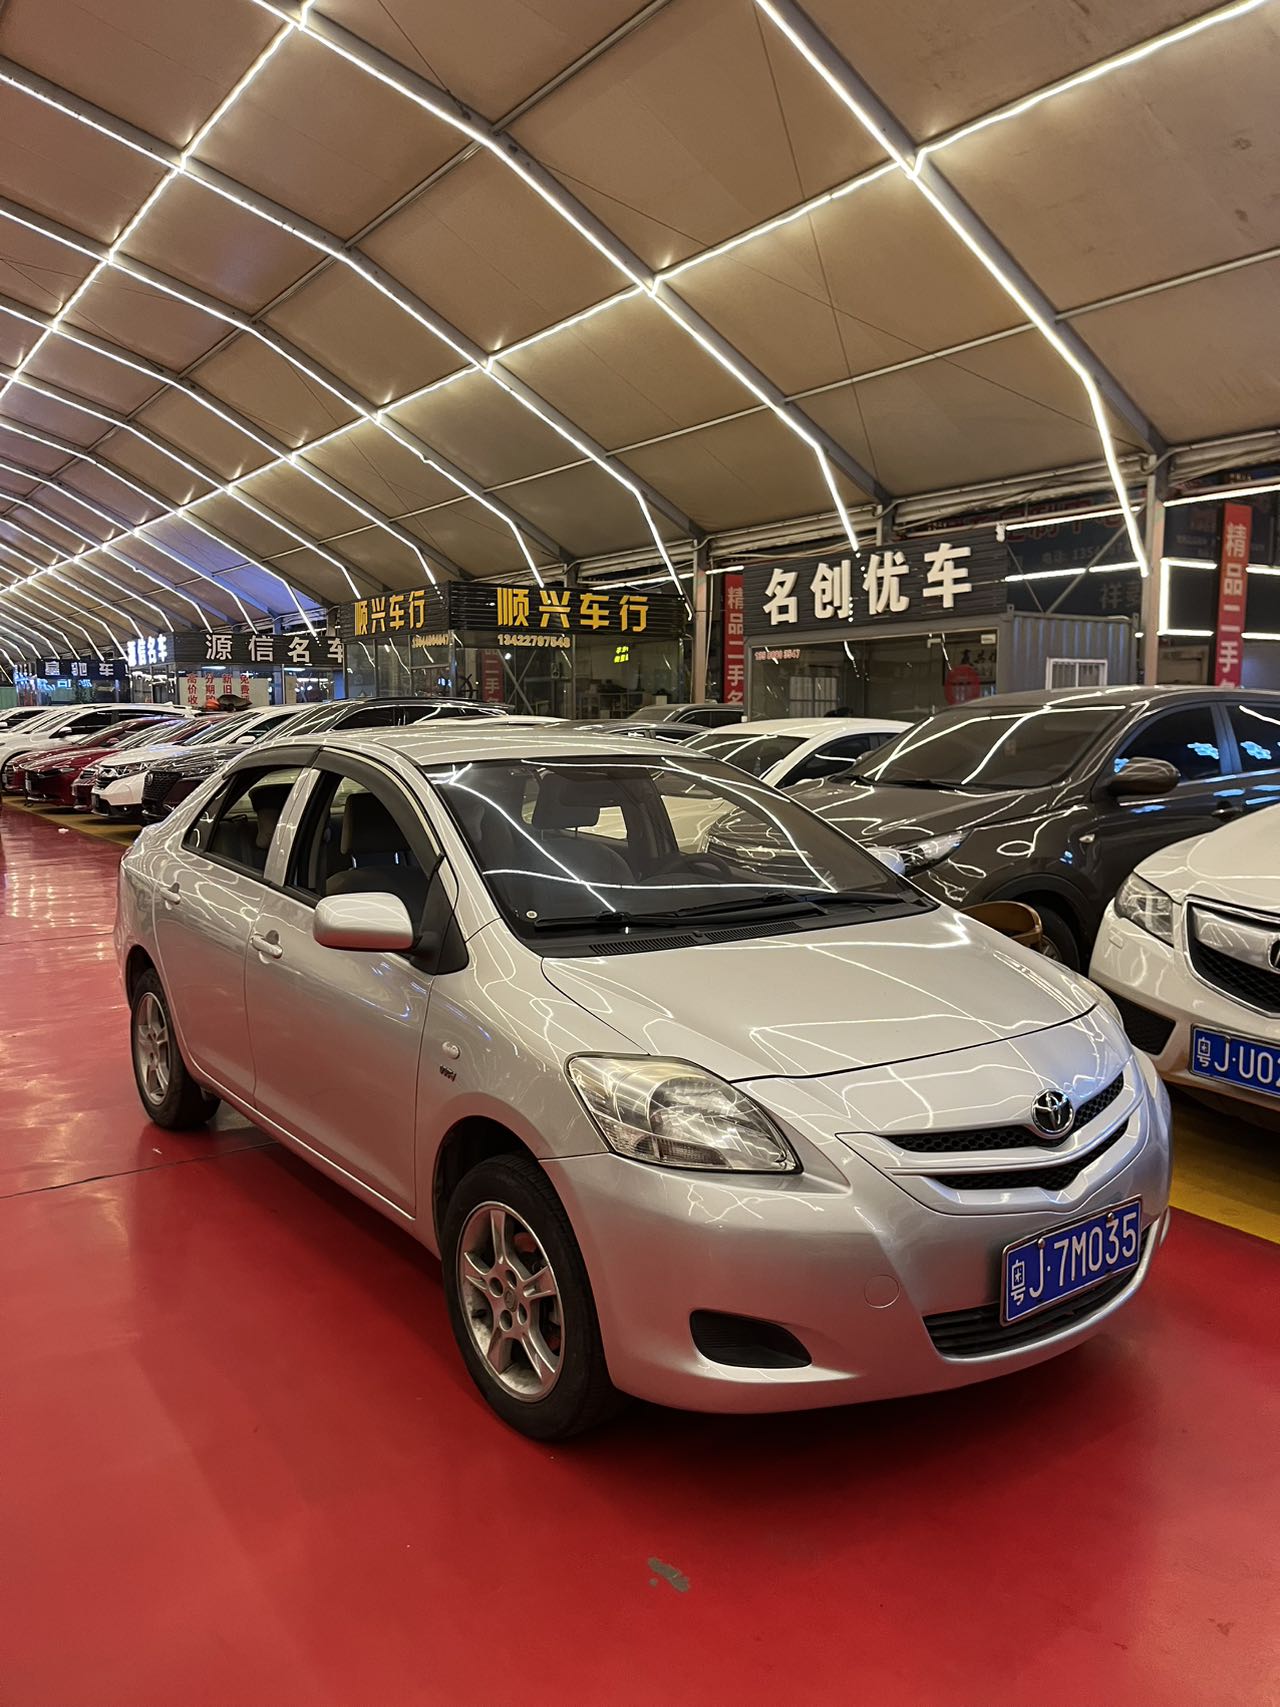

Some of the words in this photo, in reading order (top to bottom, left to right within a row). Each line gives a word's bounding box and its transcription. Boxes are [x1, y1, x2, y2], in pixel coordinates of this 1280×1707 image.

[763, 542, 972, 626] 名创优车
[354, 590, 425, 636] 顺兴车行
[497, 587, 649, 632] 顺兴车行
[240, 673, 250, 701] 免费
[1011, 1212, 1137, 1306] 粤J·7M035
